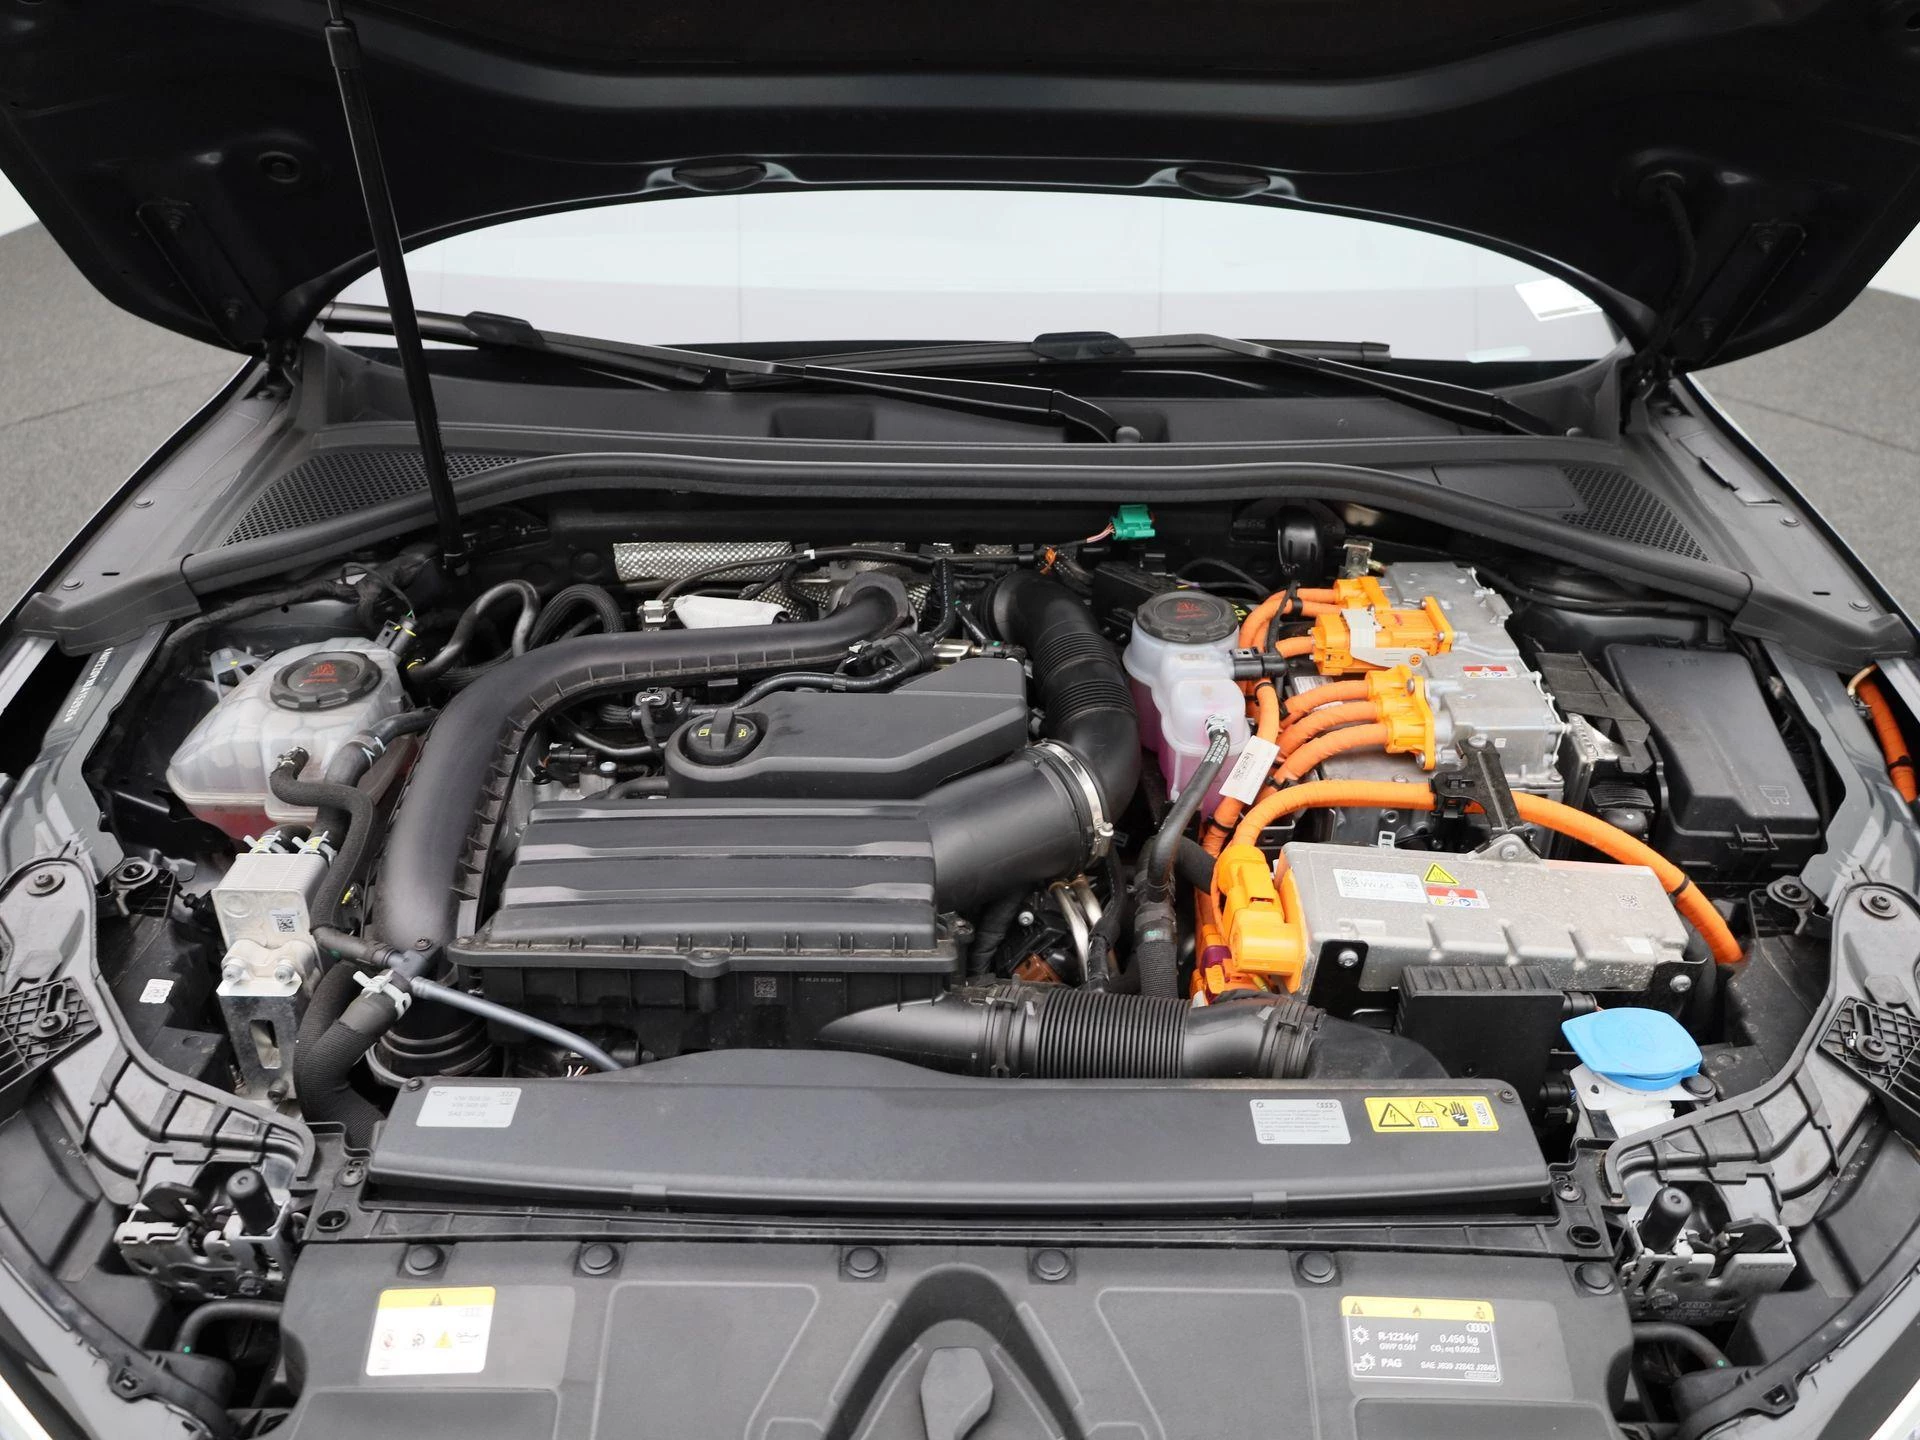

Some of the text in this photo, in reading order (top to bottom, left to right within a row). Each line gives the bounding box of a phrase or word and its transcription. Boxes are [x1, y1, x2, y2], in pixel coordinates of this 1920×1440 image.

[1377, 1331, 1420, 1343] R-1234yf
[1466, 1335, 1479, 1346] kg
[1381, 1358, 1402, 1368] PAG
